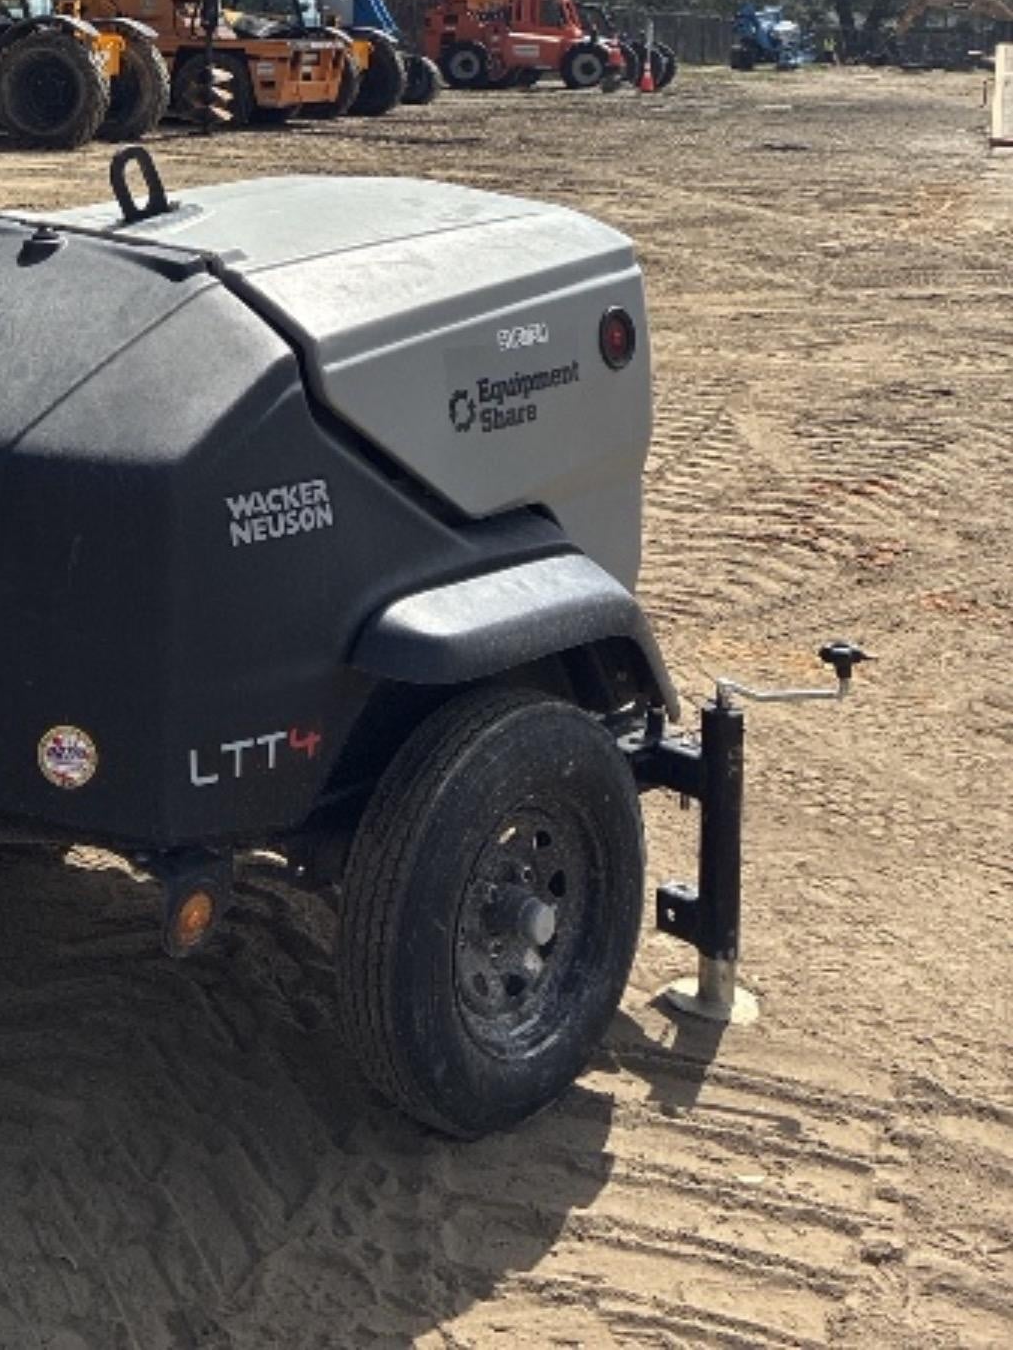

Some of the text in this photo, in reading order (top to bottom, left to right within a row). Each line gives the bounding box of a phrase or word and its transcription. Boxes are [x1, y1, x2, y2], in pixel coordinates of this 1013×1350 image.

[476, 359, 579, 405] Equipment
[479, 404, 537, 432] Share
[225, 479, 329, 520] WACKER
[229, 502, 333, 547] NEUSON
